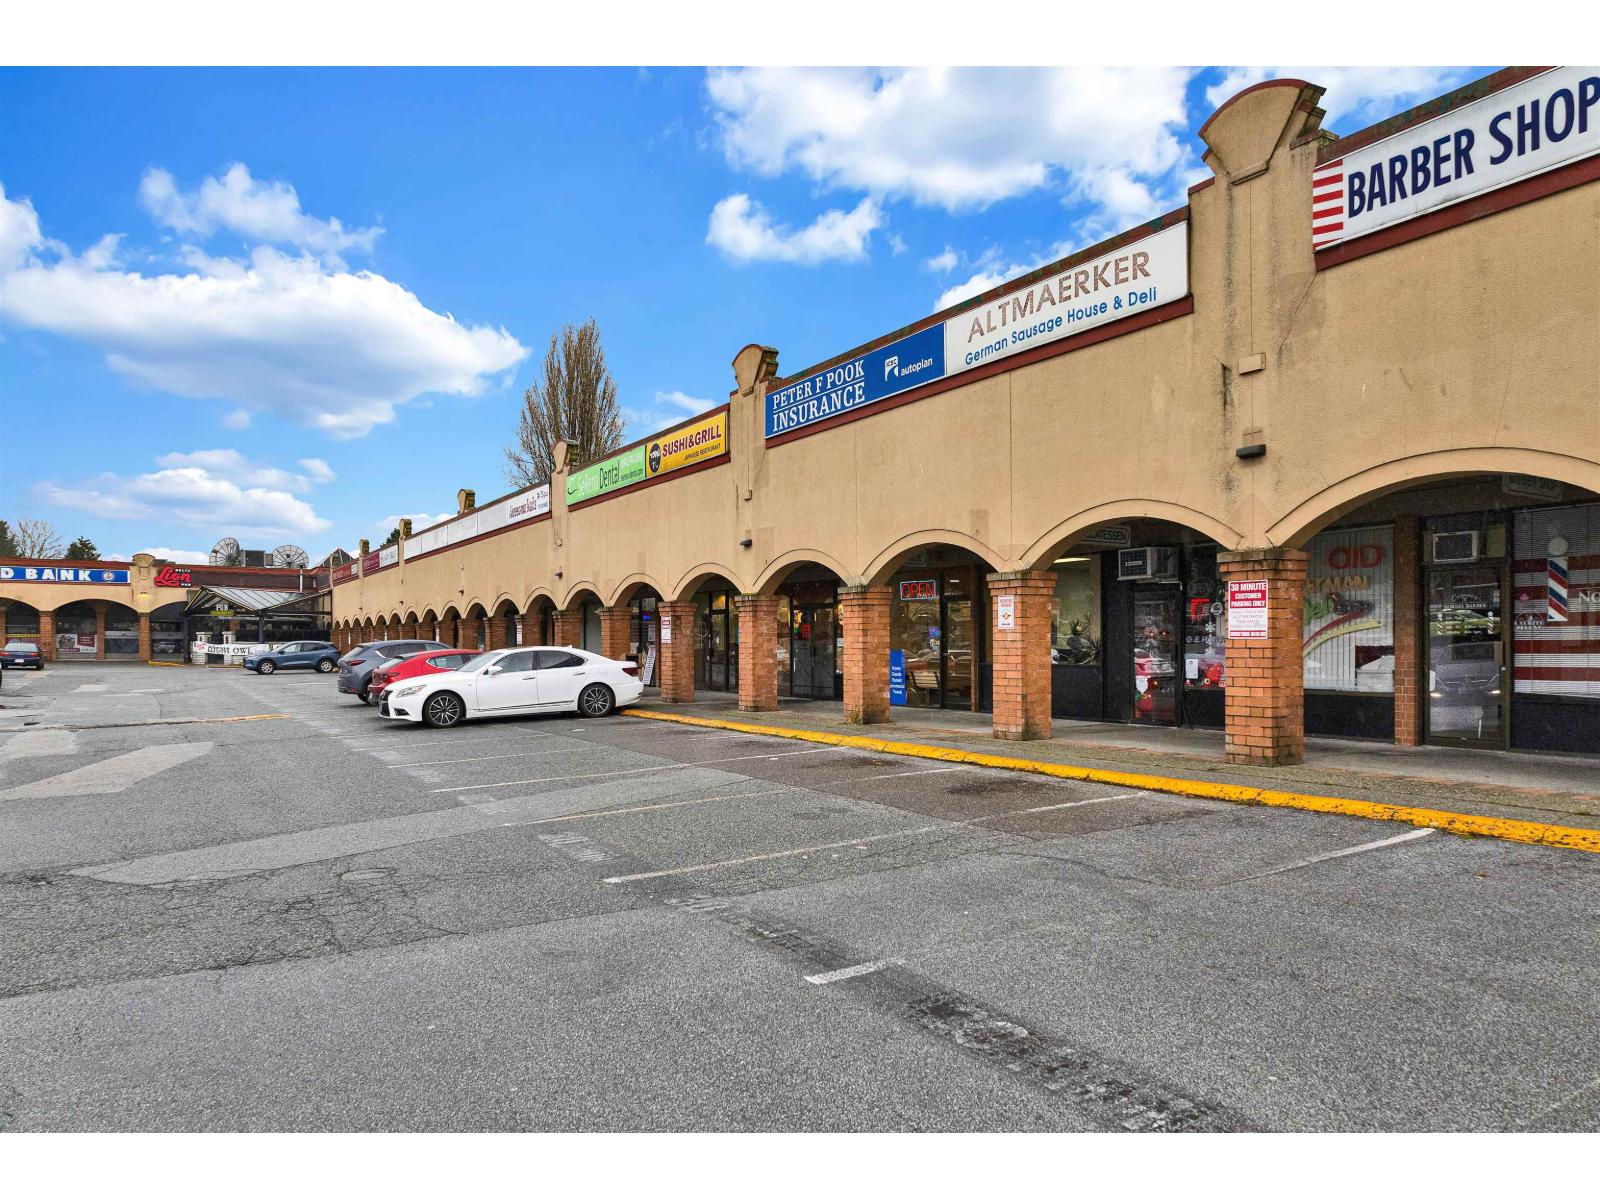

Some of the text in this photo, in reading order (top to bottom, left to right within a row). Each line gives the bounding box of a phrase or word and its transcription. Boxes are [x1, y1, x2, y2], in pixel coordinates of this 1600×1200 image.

[1348, 76, 1600, 218] BARBER SHOP
[968, 251, 1151, 343] ALTMAERKER
[965, 286, 1157, 365] German Sausage House & Deli
[900, 358, 933, 377] autoplan
[773, 360, 865, 410] PETER F POOK
[773, 382, 865, 433] INSURANCE
[600, 459, 620, 489] Dental
[25, 568, 92, 581] BANK
[153, 566, 192, 587] Lion
[1240, 582, 1266, 591] MINUTE
[902, 583, 935, 598] OPEN
